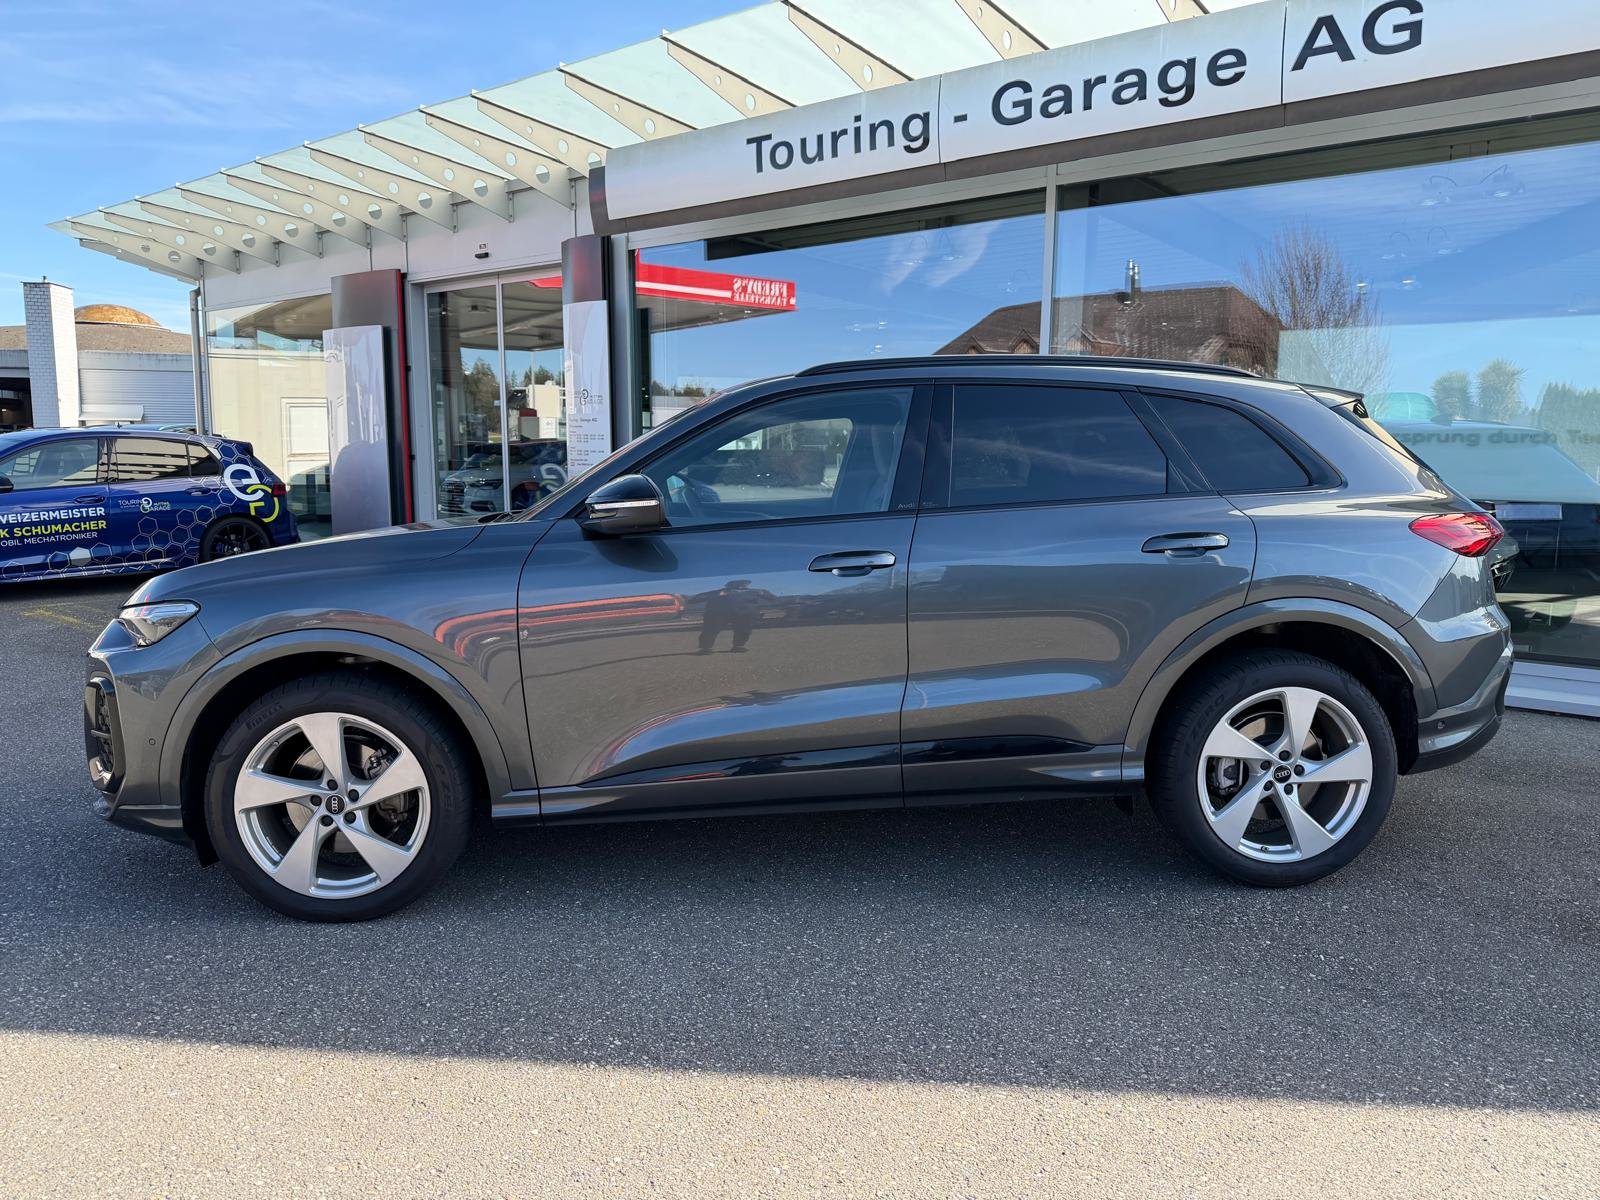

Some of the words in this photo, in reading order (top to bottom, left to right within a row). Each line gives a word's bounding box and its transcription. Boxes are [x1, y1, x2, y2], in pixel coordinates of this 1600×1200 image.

[746, 111, 930, 174] Touring
[953, 113, 968, 123] -
[991, 48, 1248, 126] Garage
[1290, 0, 1424, 72] AG
[13, 520, 107, 537] SCHUMACHER
[0, 539, 22, 547] OBIL
[24, 531, 99, 545] MECHATRONIKER
